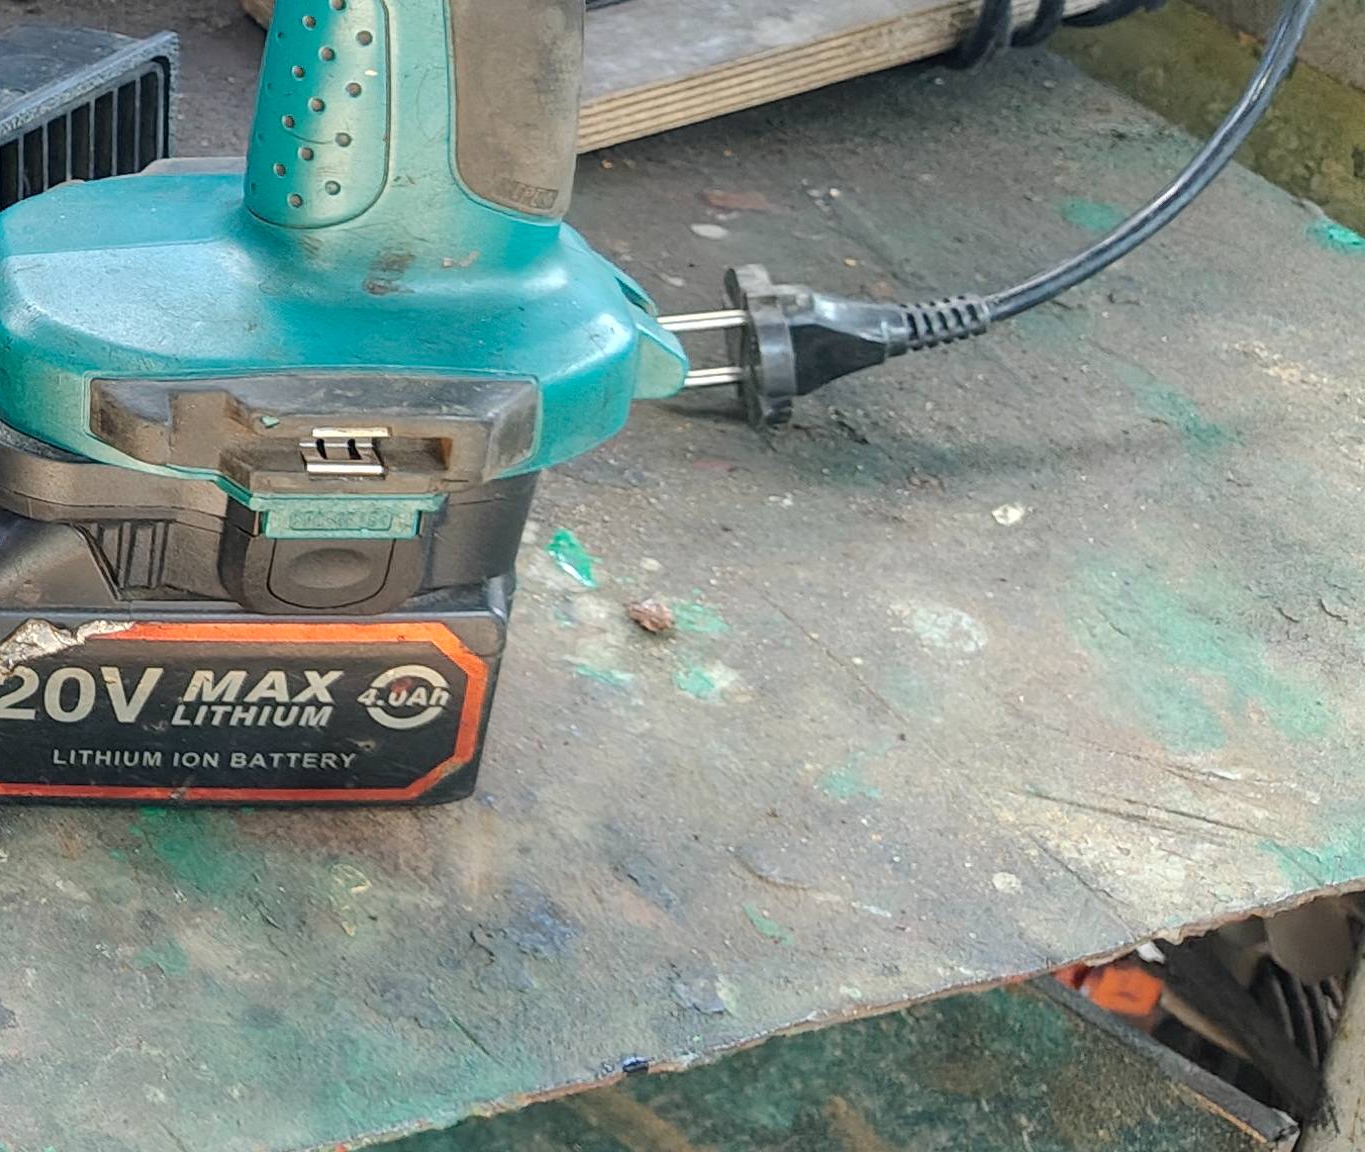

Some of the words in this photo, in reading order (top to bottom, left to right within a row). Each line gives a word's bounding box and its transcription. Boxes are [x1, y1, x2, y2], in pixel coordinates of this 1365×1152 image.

[182, 670, 345, 703] MAX
[171, 704, 334, 728] LITHIUM
[52, 749, 164, 768] LITHIUM
[172, 750, 224, 768] ION
[230, 750, 356, 770] BATTERY
